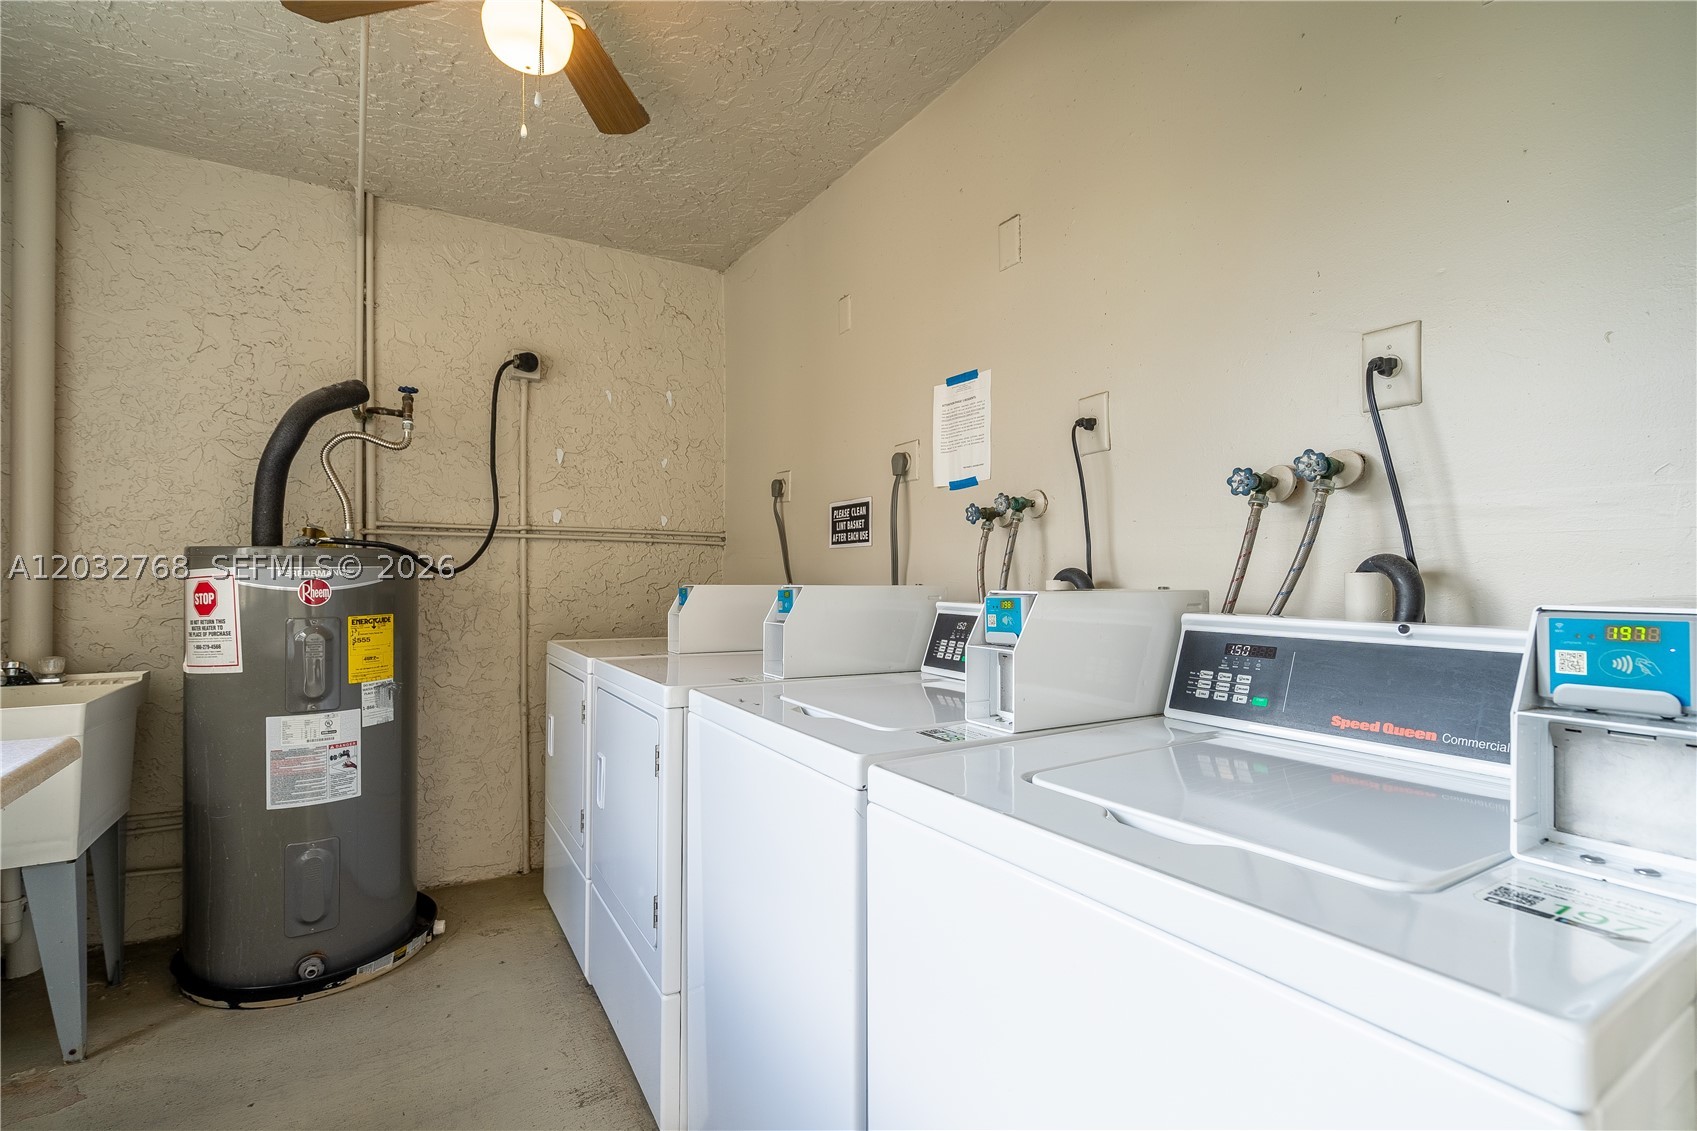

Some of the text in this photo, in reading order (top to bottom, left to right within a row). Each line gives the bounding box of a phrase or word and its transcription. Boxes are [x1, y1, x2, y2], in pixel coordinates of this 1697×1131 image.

[833, 506, 867, 520] PLEASE CLEAN
[836, 519, 865, 531] LINT BASKET
[832, 530, 869, 542] AFTER EACH USE
[302, 580, 330, 602] Rheem
[194, 592, 215, 605] STOP
[1612, 626, 1647, 641] 197
[1331, 714, 1510, 753] Speed Queen Commercial
